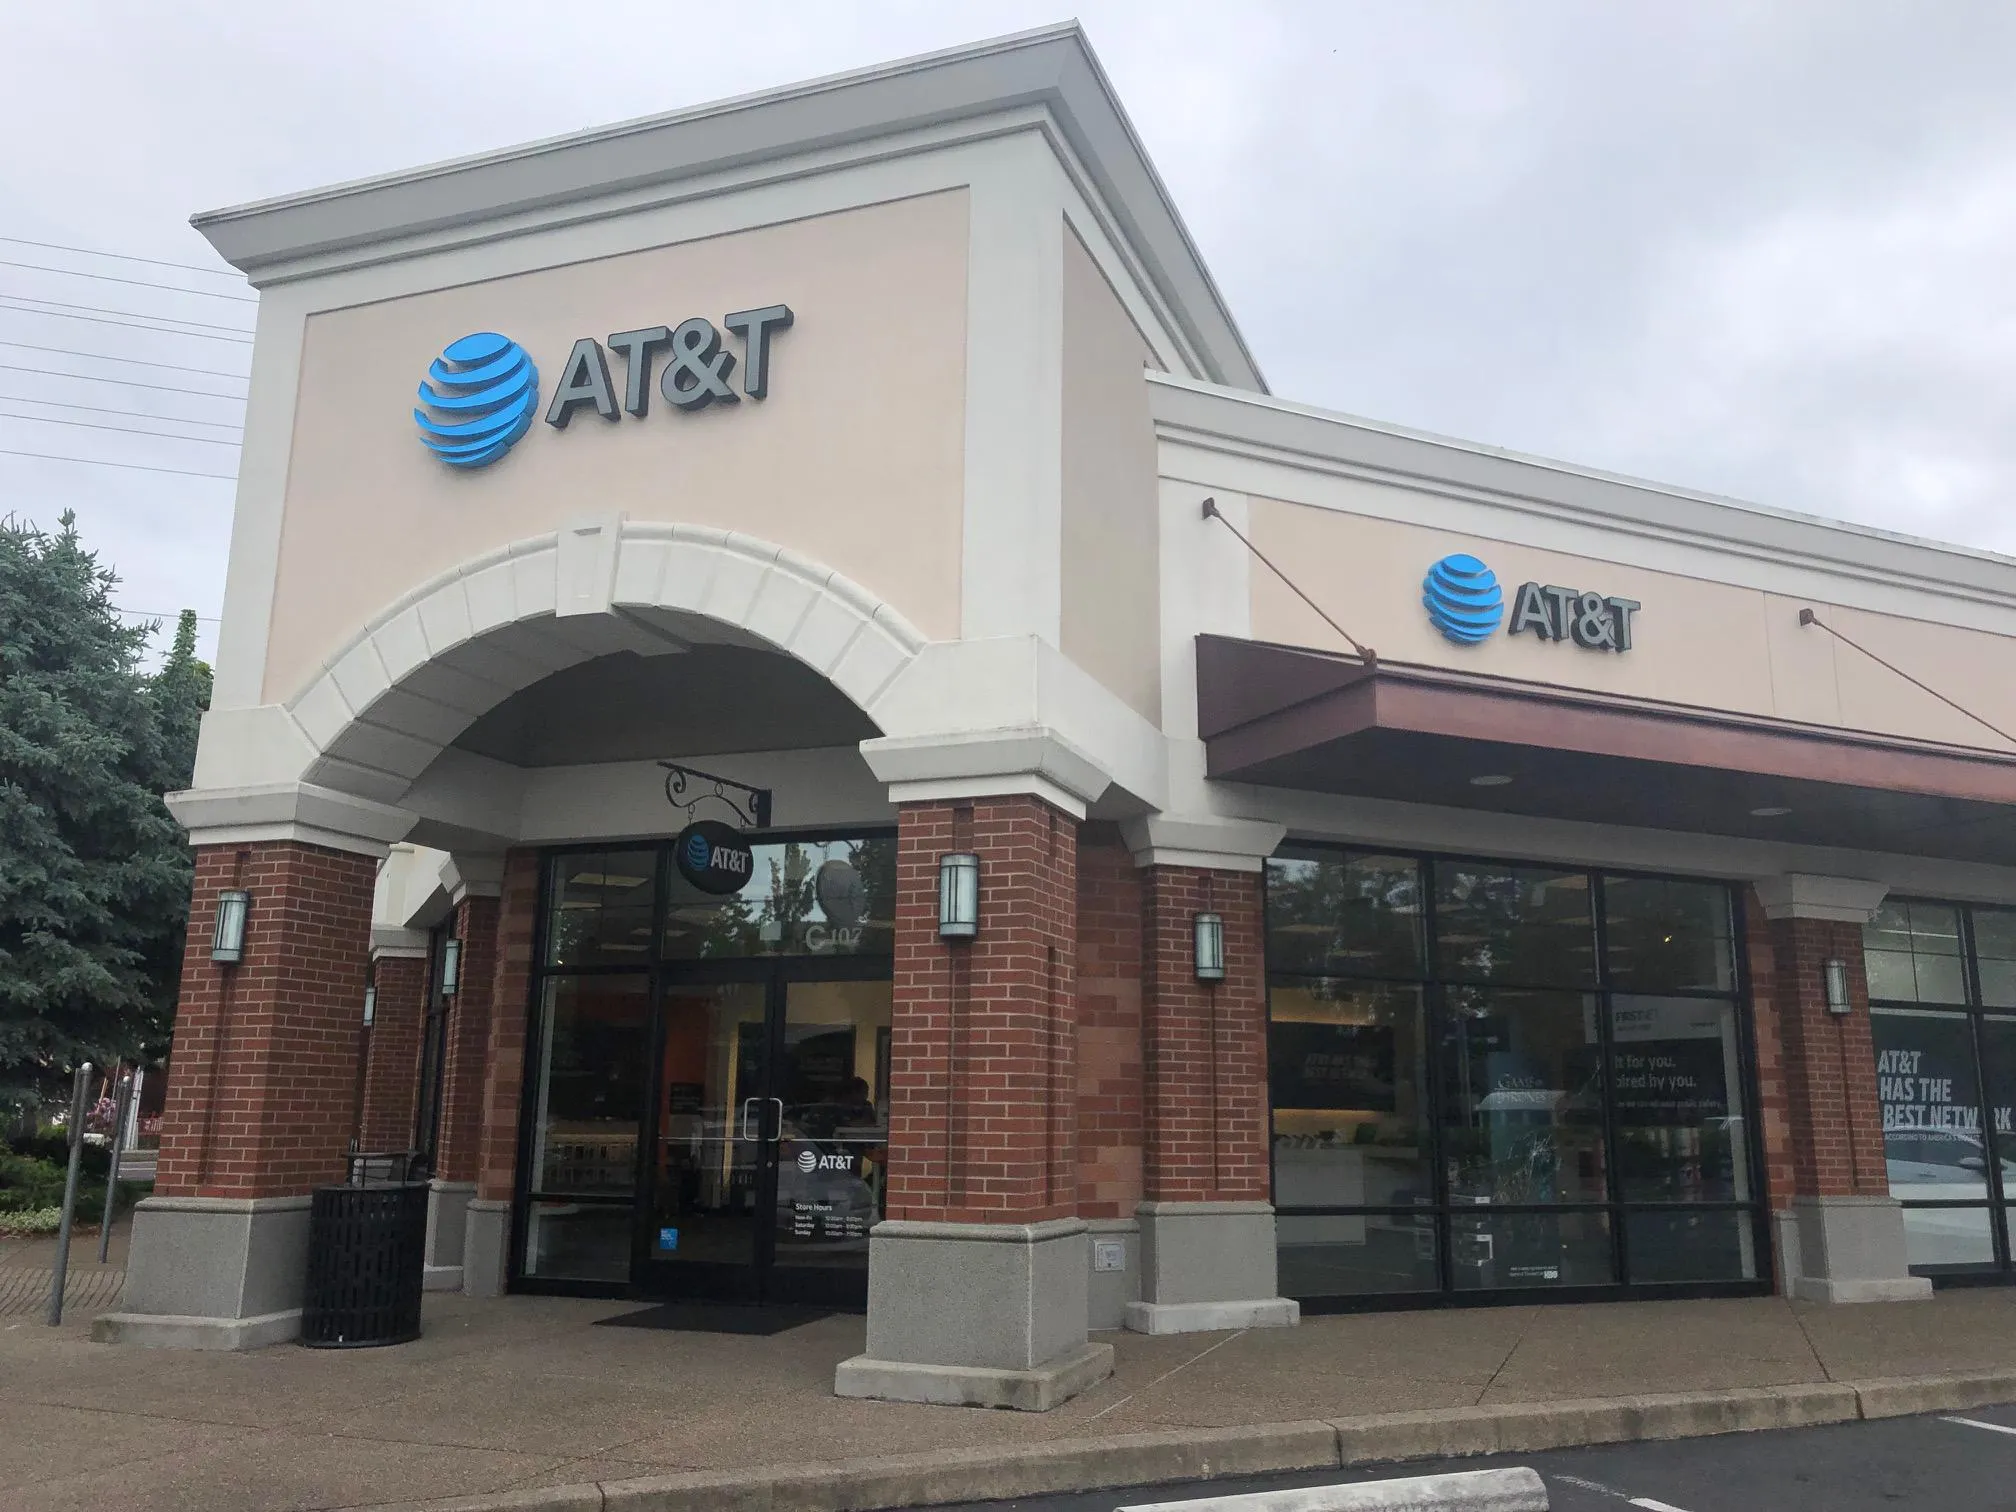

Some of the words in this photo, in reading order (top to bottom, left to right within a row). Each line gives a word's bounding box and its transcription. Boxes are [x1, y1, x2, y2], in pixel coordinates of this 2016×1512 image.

[545, 304, 794, 429] AT&T
[1508, 582, 1641, 652] AT&T
[711, 846, 749, 873] AT&T
[1627, 1054, 1645, 1068] for
[1648, 1057, 1676, 1070] you.
[1878, 1050, 1921, 1074] AT&T
[1669, 1076, 1696, 1091] you.
[1880, 1077, 1914, 1101] HAS
[1919, 1078, 1952, 1102] THE
[1883, 1104, 1927, 1129] BEST
[1930, 1106, 2011, 1130] NETWRK
[818, 1155, 854, 1169] AT&T
[795, 1203, 813, 1211] Store
[814, 1203, 832, 1212] Hours
